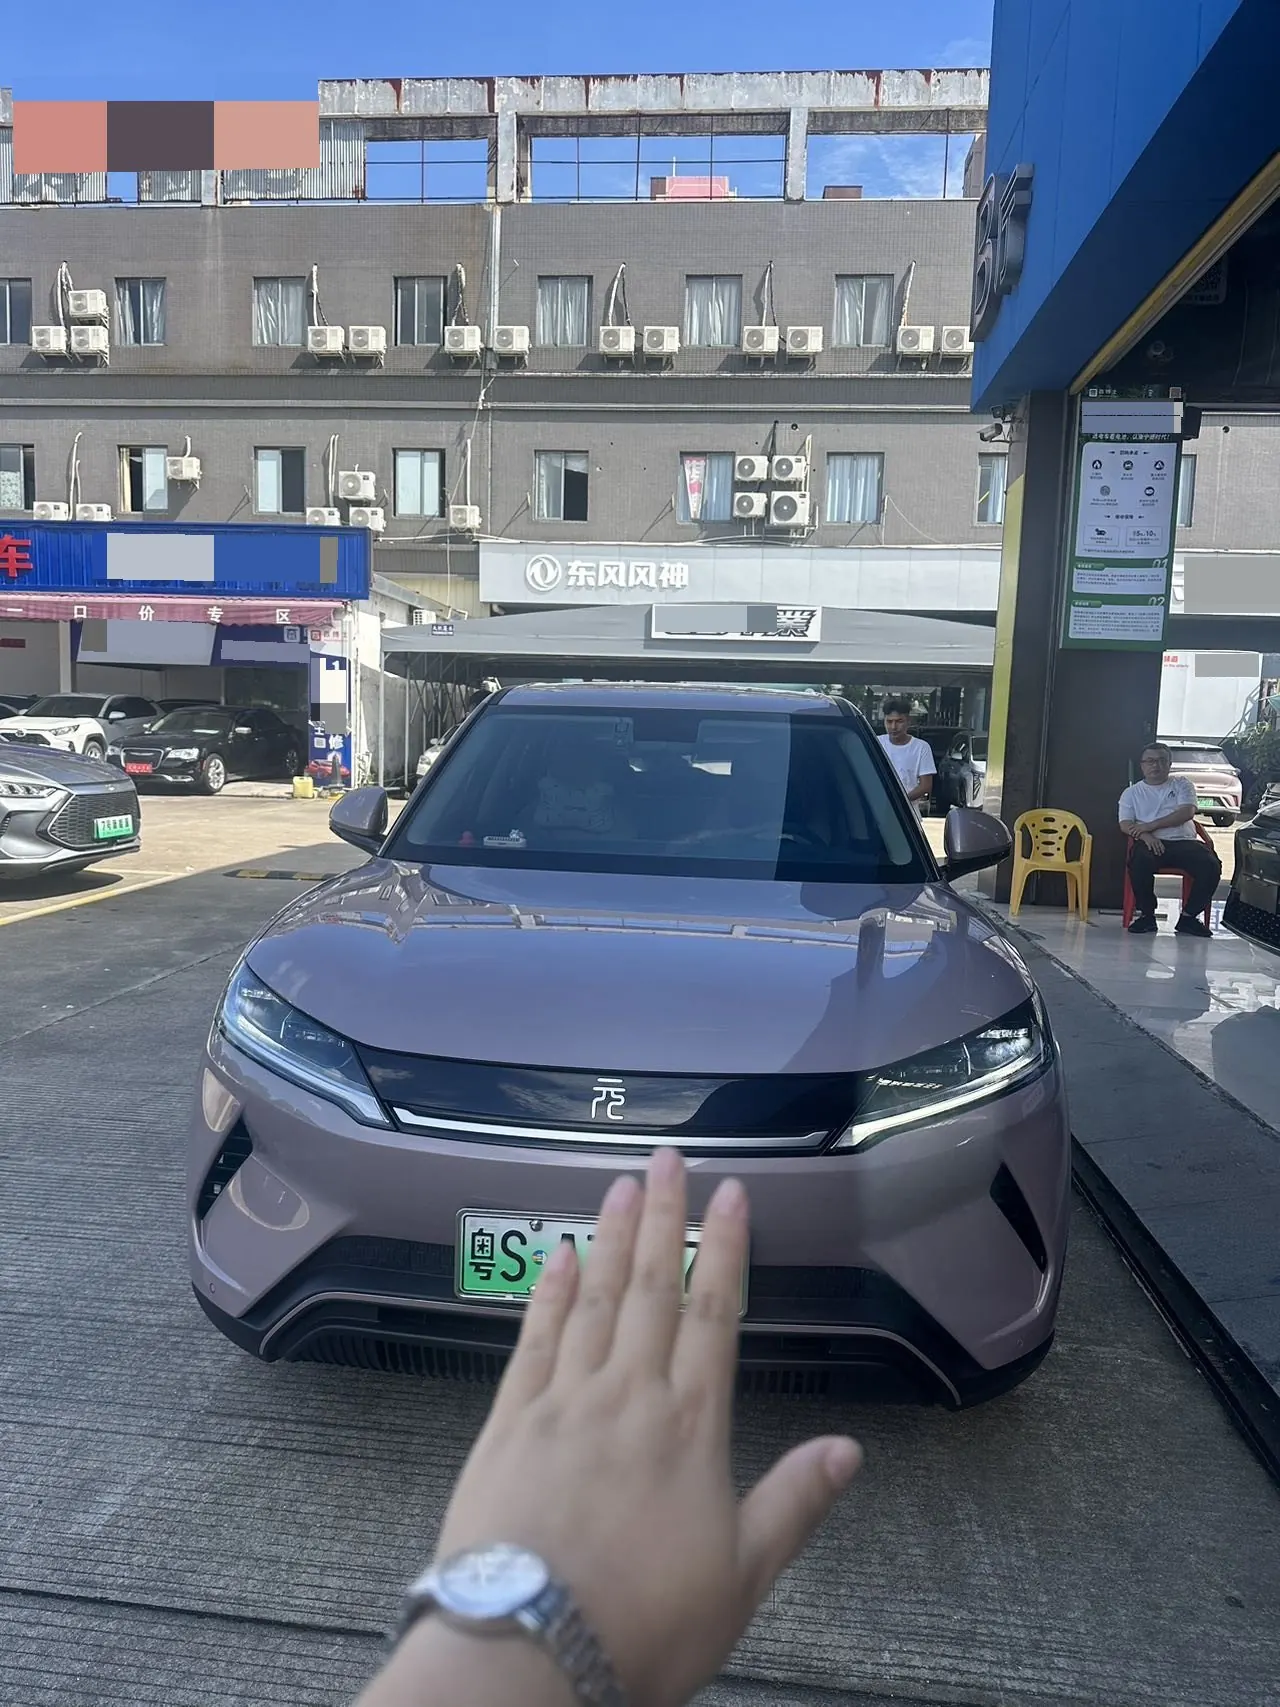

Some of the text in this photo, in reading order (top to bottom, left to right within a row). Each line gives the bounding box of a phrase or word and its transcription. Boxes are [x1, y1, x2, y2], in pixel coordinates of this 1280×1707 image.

[0, 534, 33, 578] 车
[567, 560, 690, 589] 东风风神
[591, 1077, 626, 1120] 元
